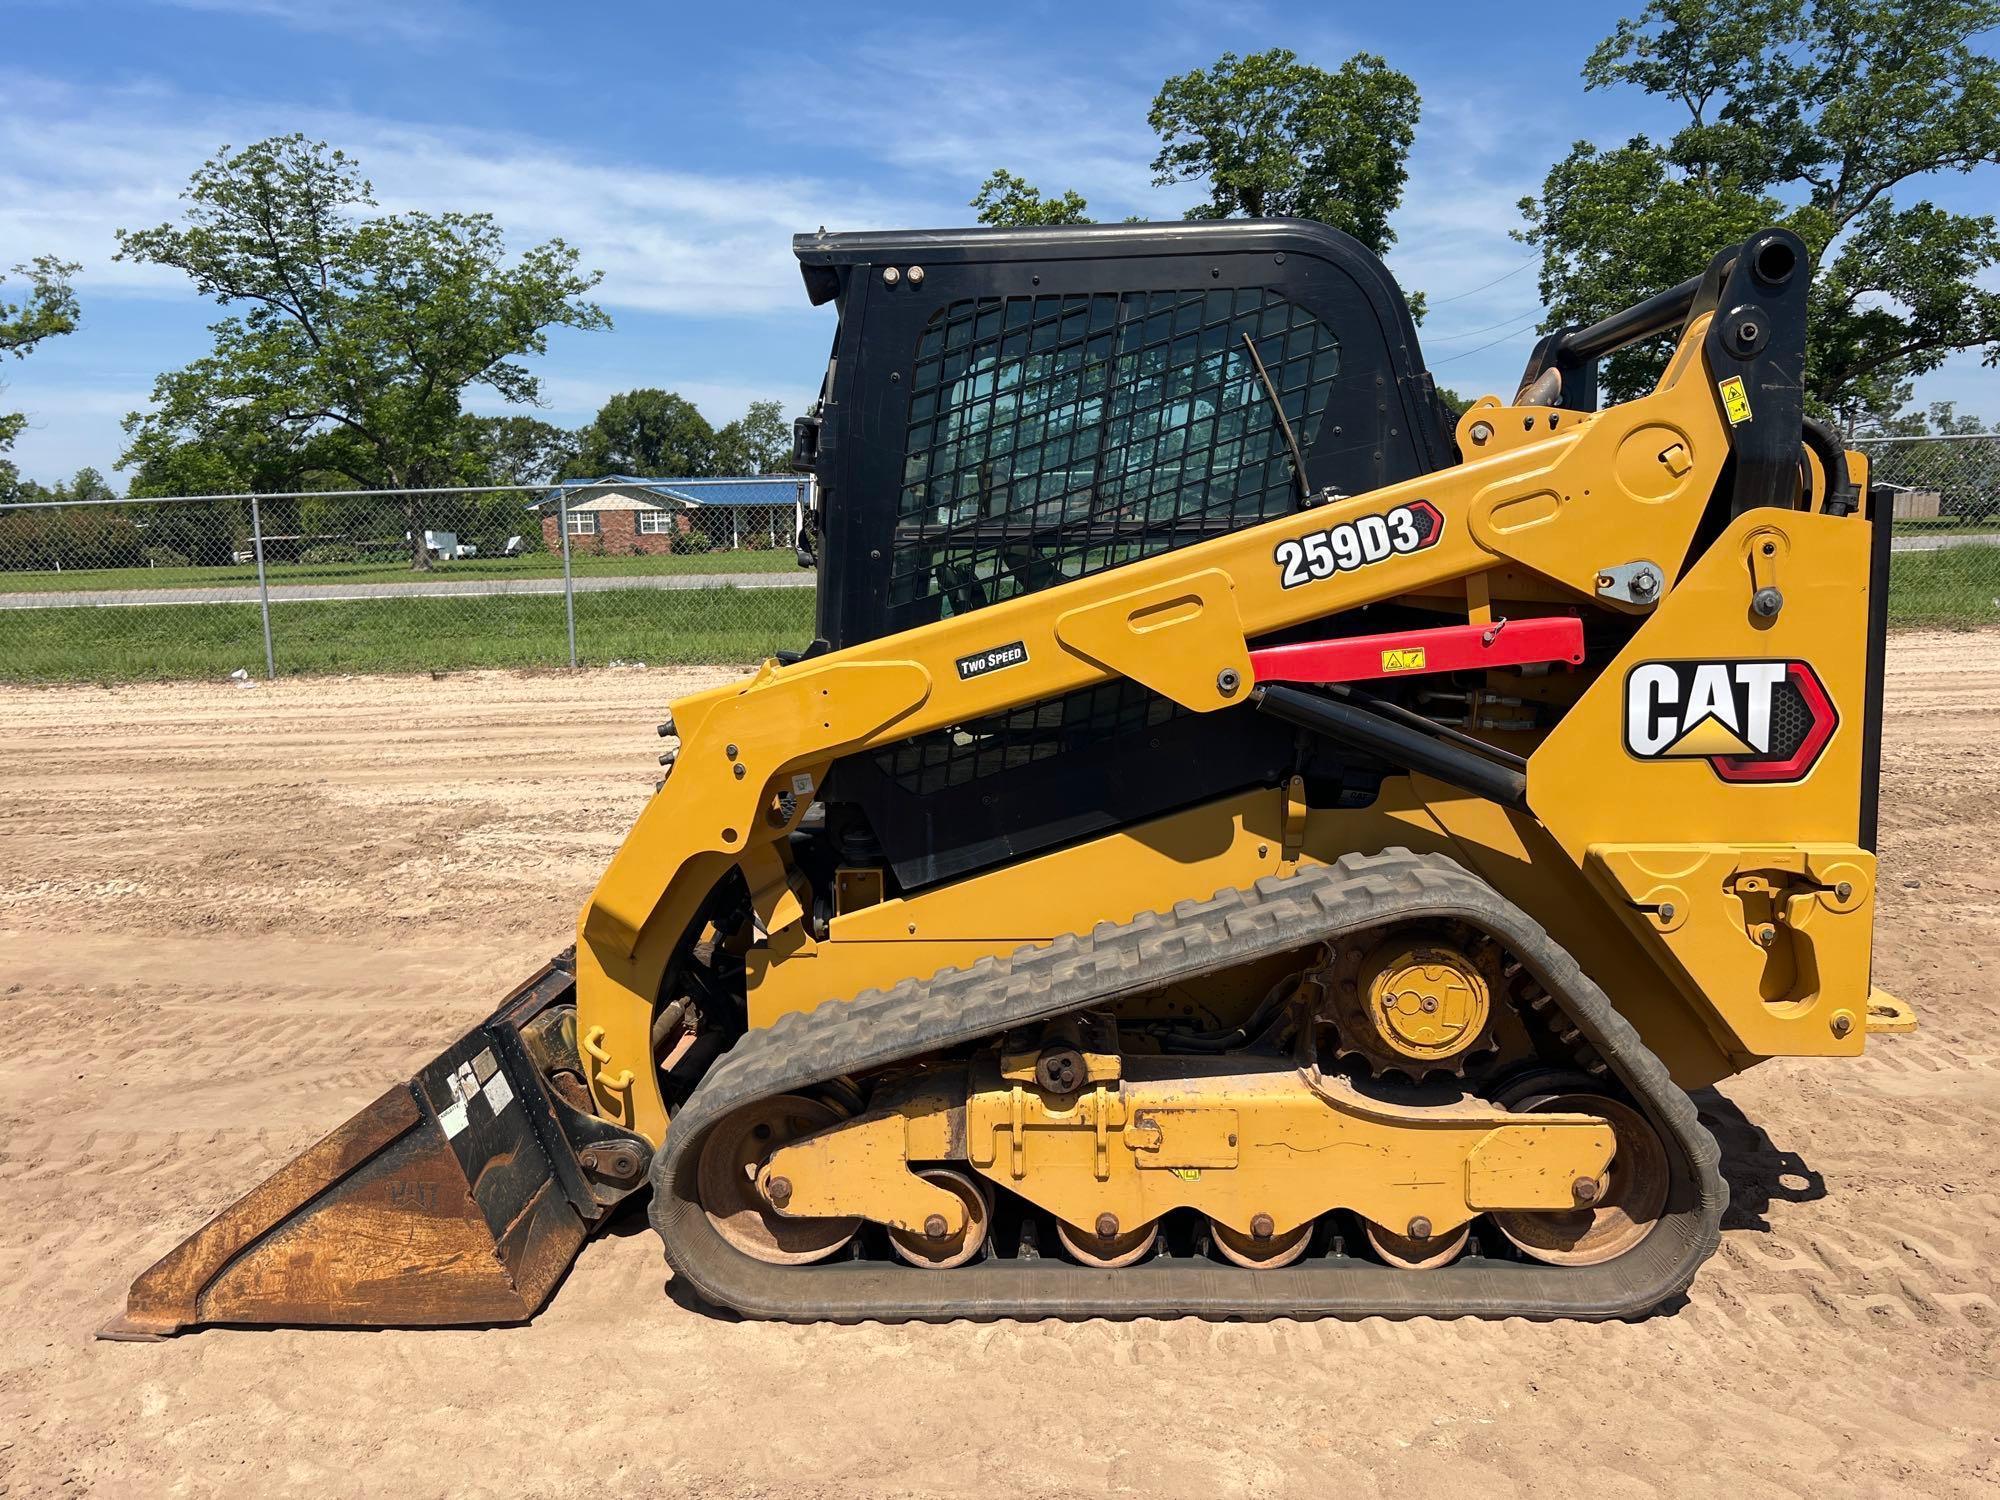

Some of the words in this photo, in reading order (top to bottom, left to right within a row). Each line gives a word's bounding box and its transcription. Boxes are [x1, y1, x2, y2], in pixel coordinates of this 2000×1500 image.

[1276, 507, 1420, 587] 259D3
[961, 658, 985, 674] TWO
[988, 648, 1021, 666] SPEED
[1628, 662, 1786, 755] CAT
